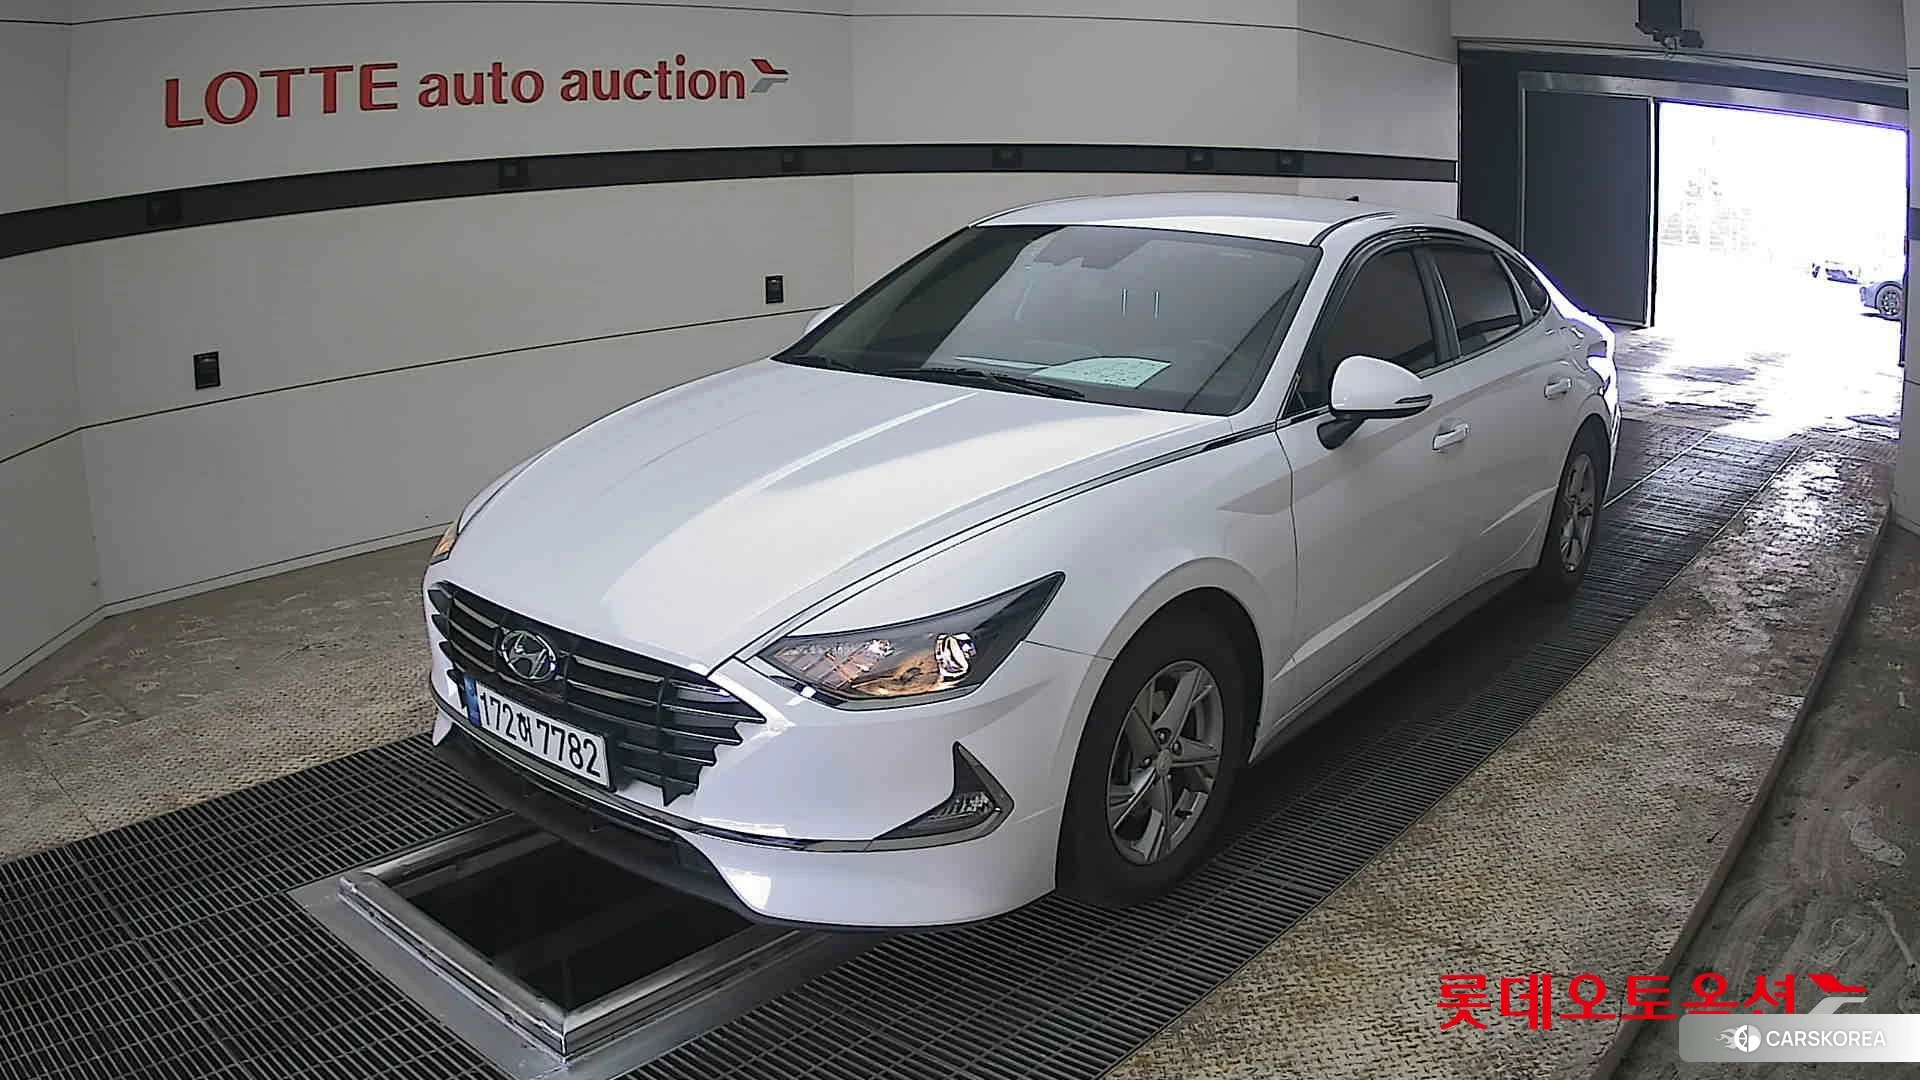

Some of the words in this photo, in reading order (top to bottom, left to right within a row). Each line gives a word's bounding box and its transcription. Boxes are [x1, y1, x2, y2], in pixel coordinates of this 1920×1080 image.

[164, 62, 399, 128] LOTTE
[418, 61, 544, 108] auto
[559, 54, 746, 102] auction
[536, 719, 601, 778] 7782
